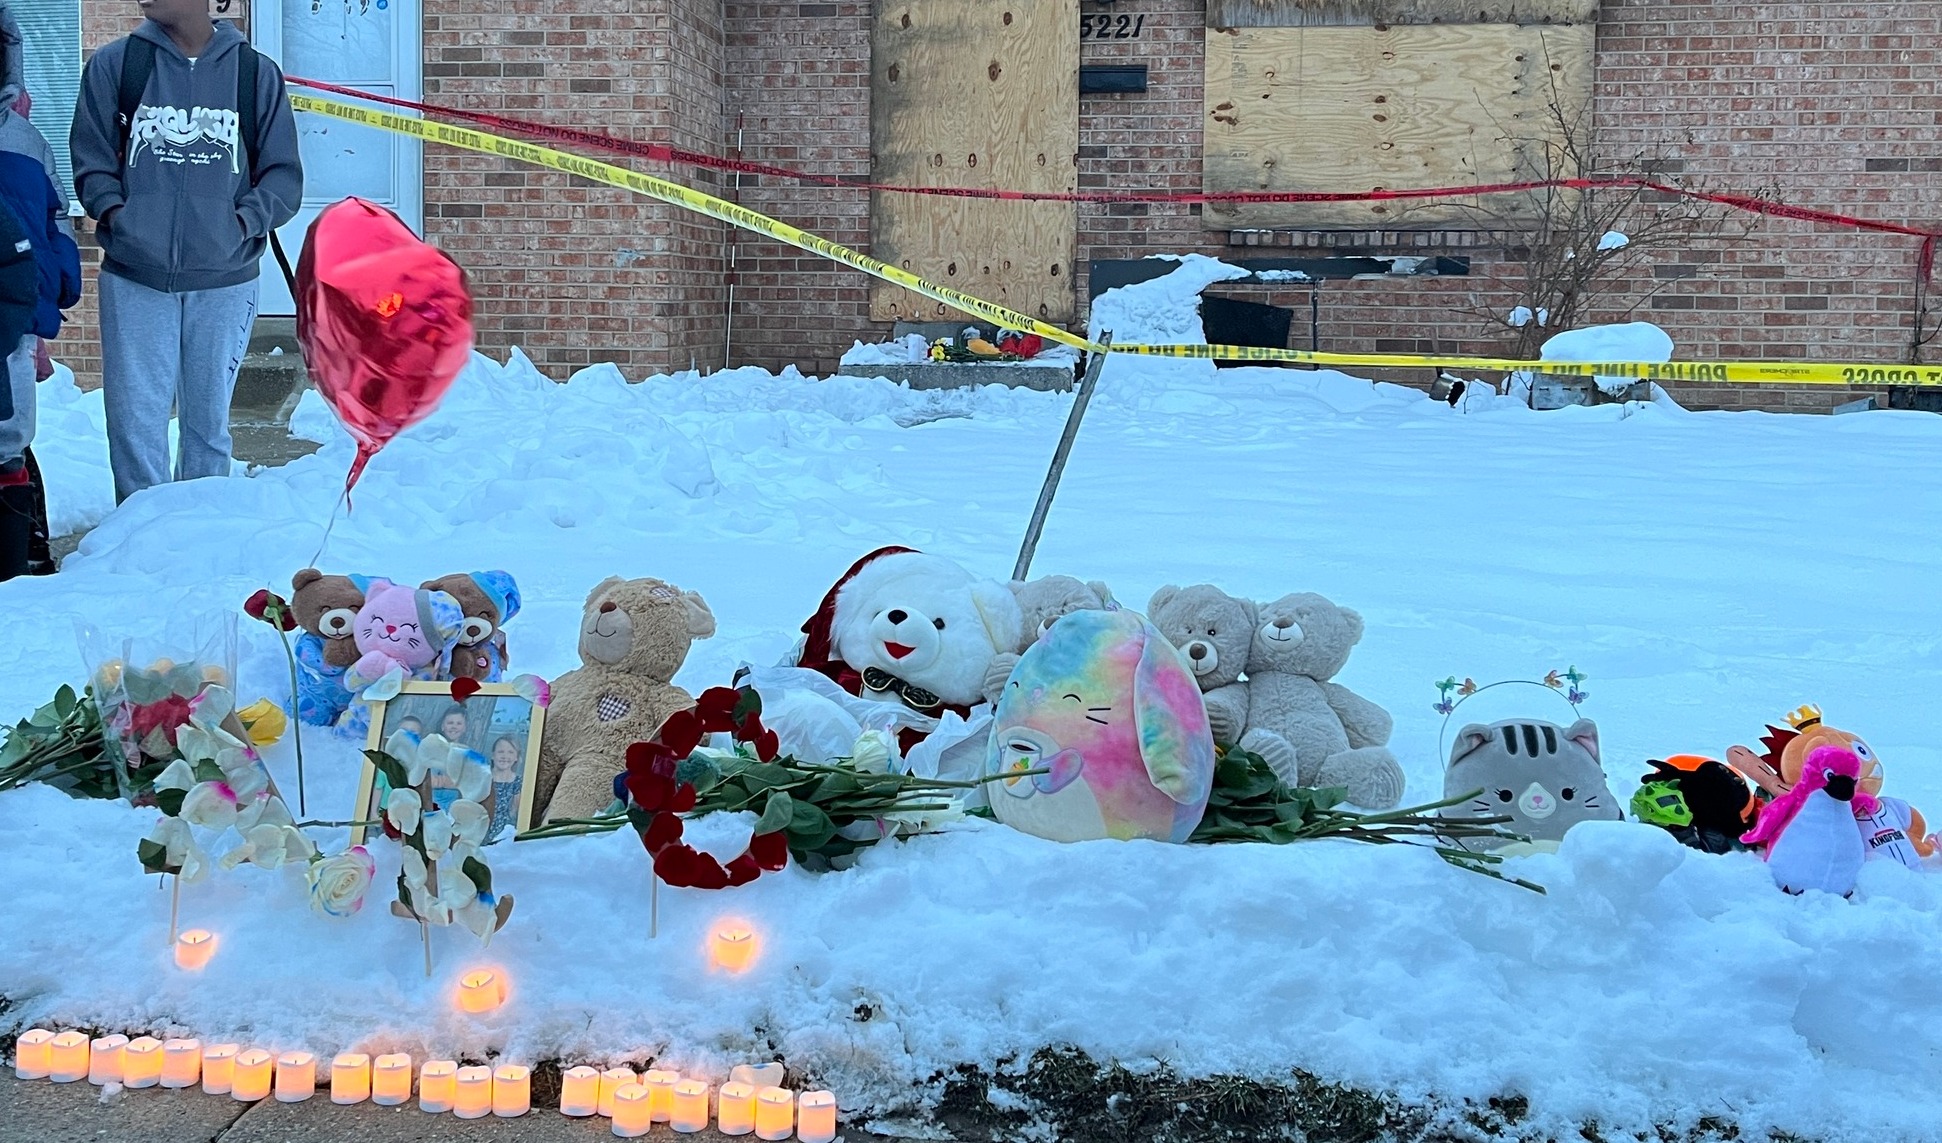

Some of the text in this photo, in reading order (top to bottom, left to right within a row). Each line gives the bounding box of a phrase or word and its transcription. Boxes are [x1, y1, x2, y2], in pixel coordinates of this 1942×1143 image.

[1080, 14, 1145, 39] 5221
[535, 125, 558, 138] NOT
[560, 130, 576, 141] DO
[576, 130, 615, 149] SCENE
[616, 138, 650, 157] CRIME
[669, 148, 708, 166] CROSS
[710, 156, 732, 168] NOT
[733, 161, 750, 172] DO
